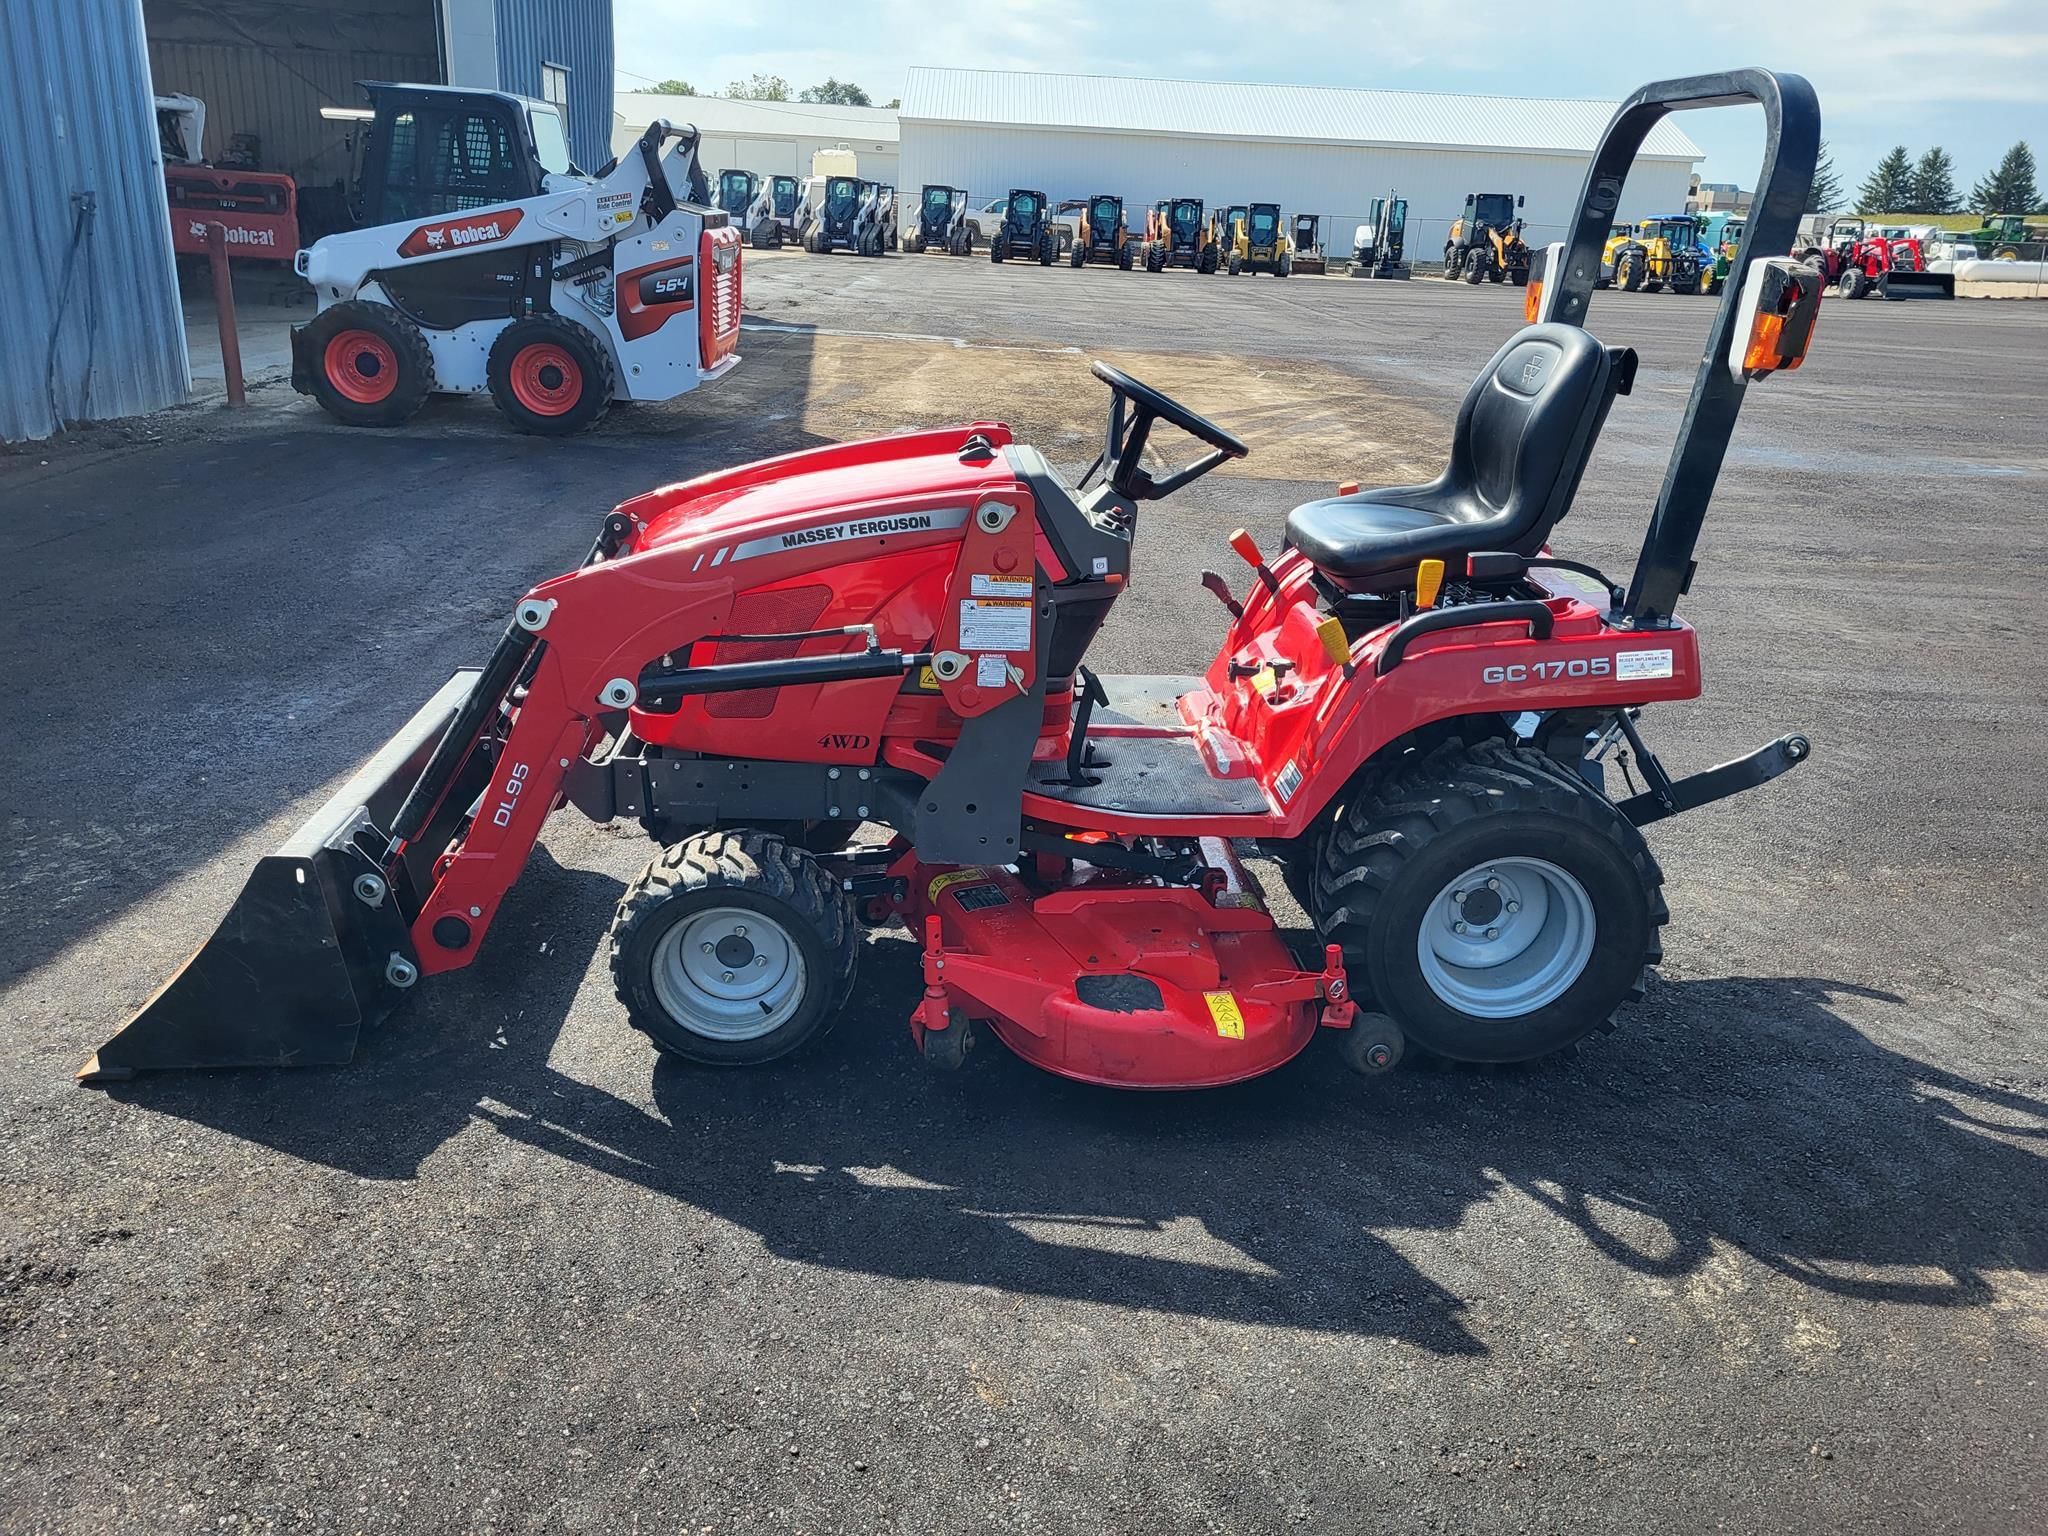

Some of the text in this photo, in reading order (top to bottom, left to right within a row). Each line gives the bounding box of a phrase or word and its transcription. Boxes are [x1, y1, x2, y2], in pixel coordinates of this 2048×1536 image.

[611, 199, 633, 208] Control
[450, 222, 501, 246] Bobcat
[655, 277, 688, 293] S64
[782, 516, 931, 548] MASSEY FERGUSON
[1000, 575, 1031, 583] WARNING
[816, 734, 870, 749] 4WD
[493, 762, 529, 827] DL95
